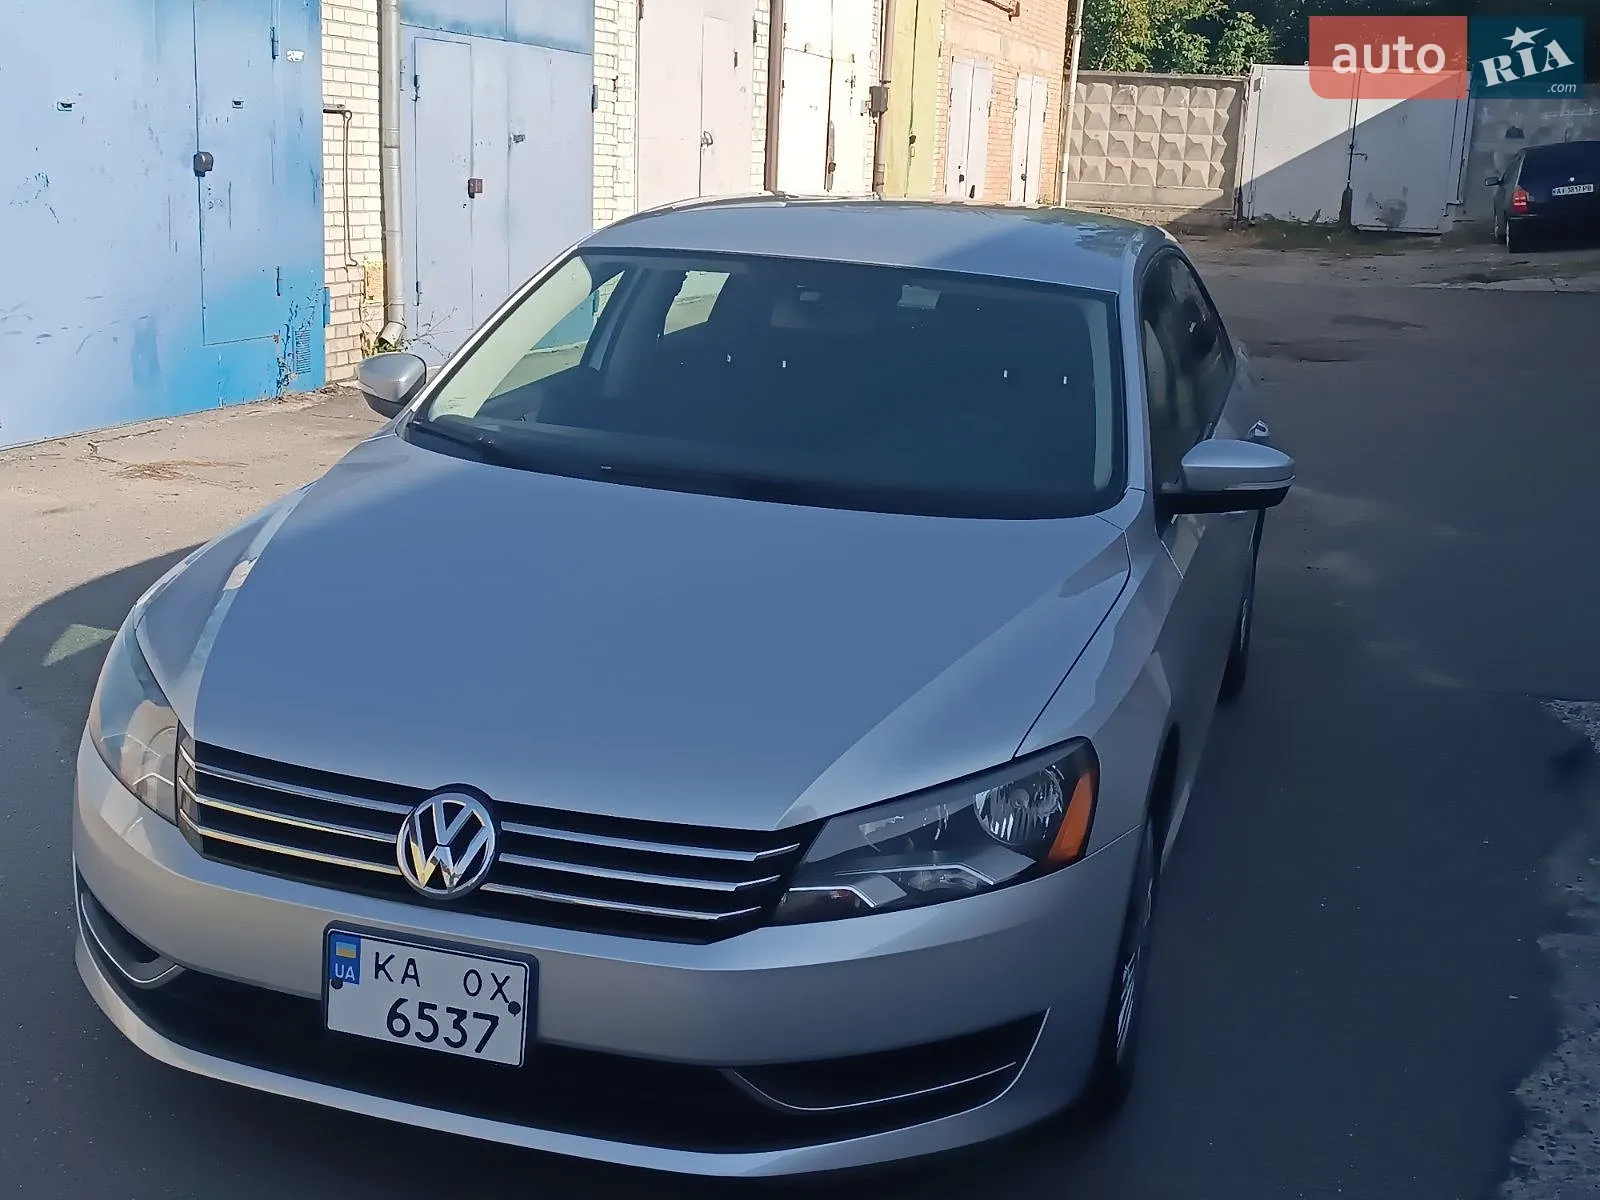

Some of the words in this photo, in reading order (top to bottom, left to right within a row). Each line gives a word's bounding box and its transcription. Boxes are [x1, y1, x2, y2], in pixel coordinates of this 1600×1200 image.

[334, 963, 356, 981] UA
[374, 951, 420, 987] KA
[463, 968, 511, 1003] OX
[386, 997, 500, 1053] 6537
